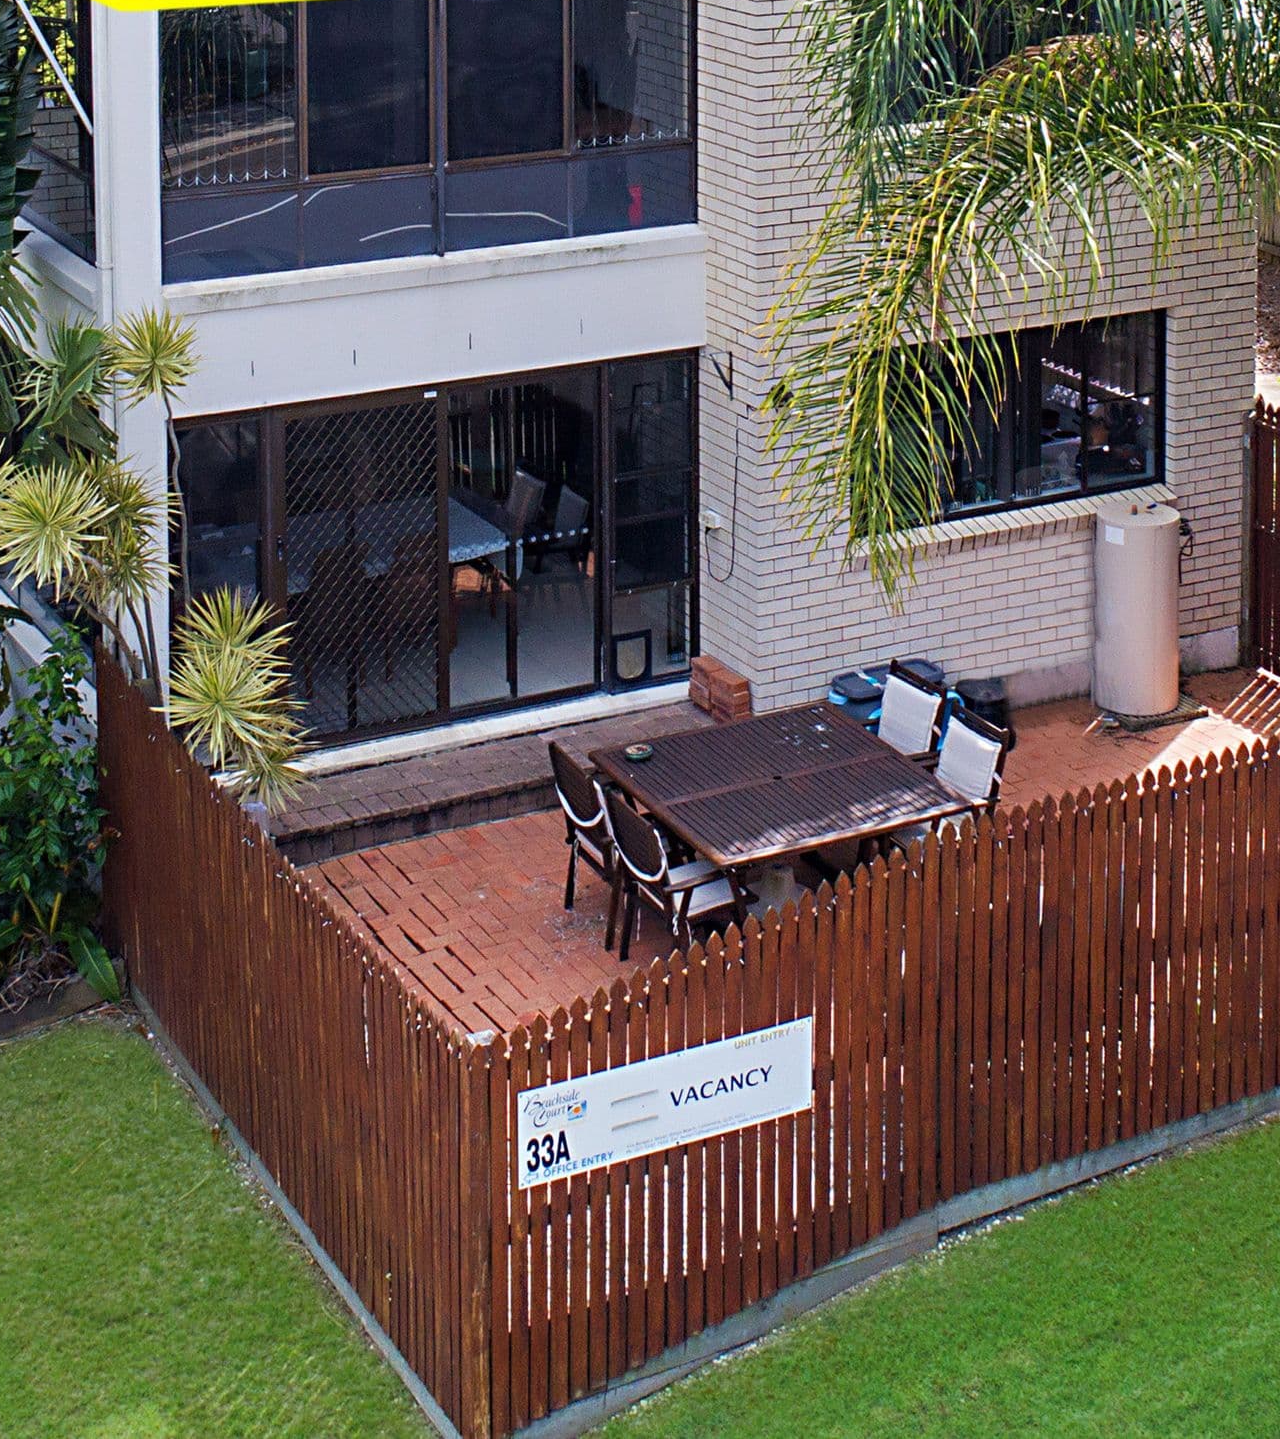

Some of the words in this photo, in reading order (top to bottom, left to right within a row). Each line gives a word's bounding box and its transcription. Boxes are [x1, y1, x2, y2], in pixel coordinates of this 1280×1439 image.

[734, 1036, 758, 1050] UNIT
[760, 1028, 791, 1043] ENTRY
[670, 1065, 772, 1107] VACANCY
[523, 1089, 580, 1115] Beachside
[532, 1104, 566, 1128] Court
[527, 1130, 570, 1172] 33A
[543, 1161, 578, 1177] OFFICE
[581, 1151, 614, 1166] ENTRY
